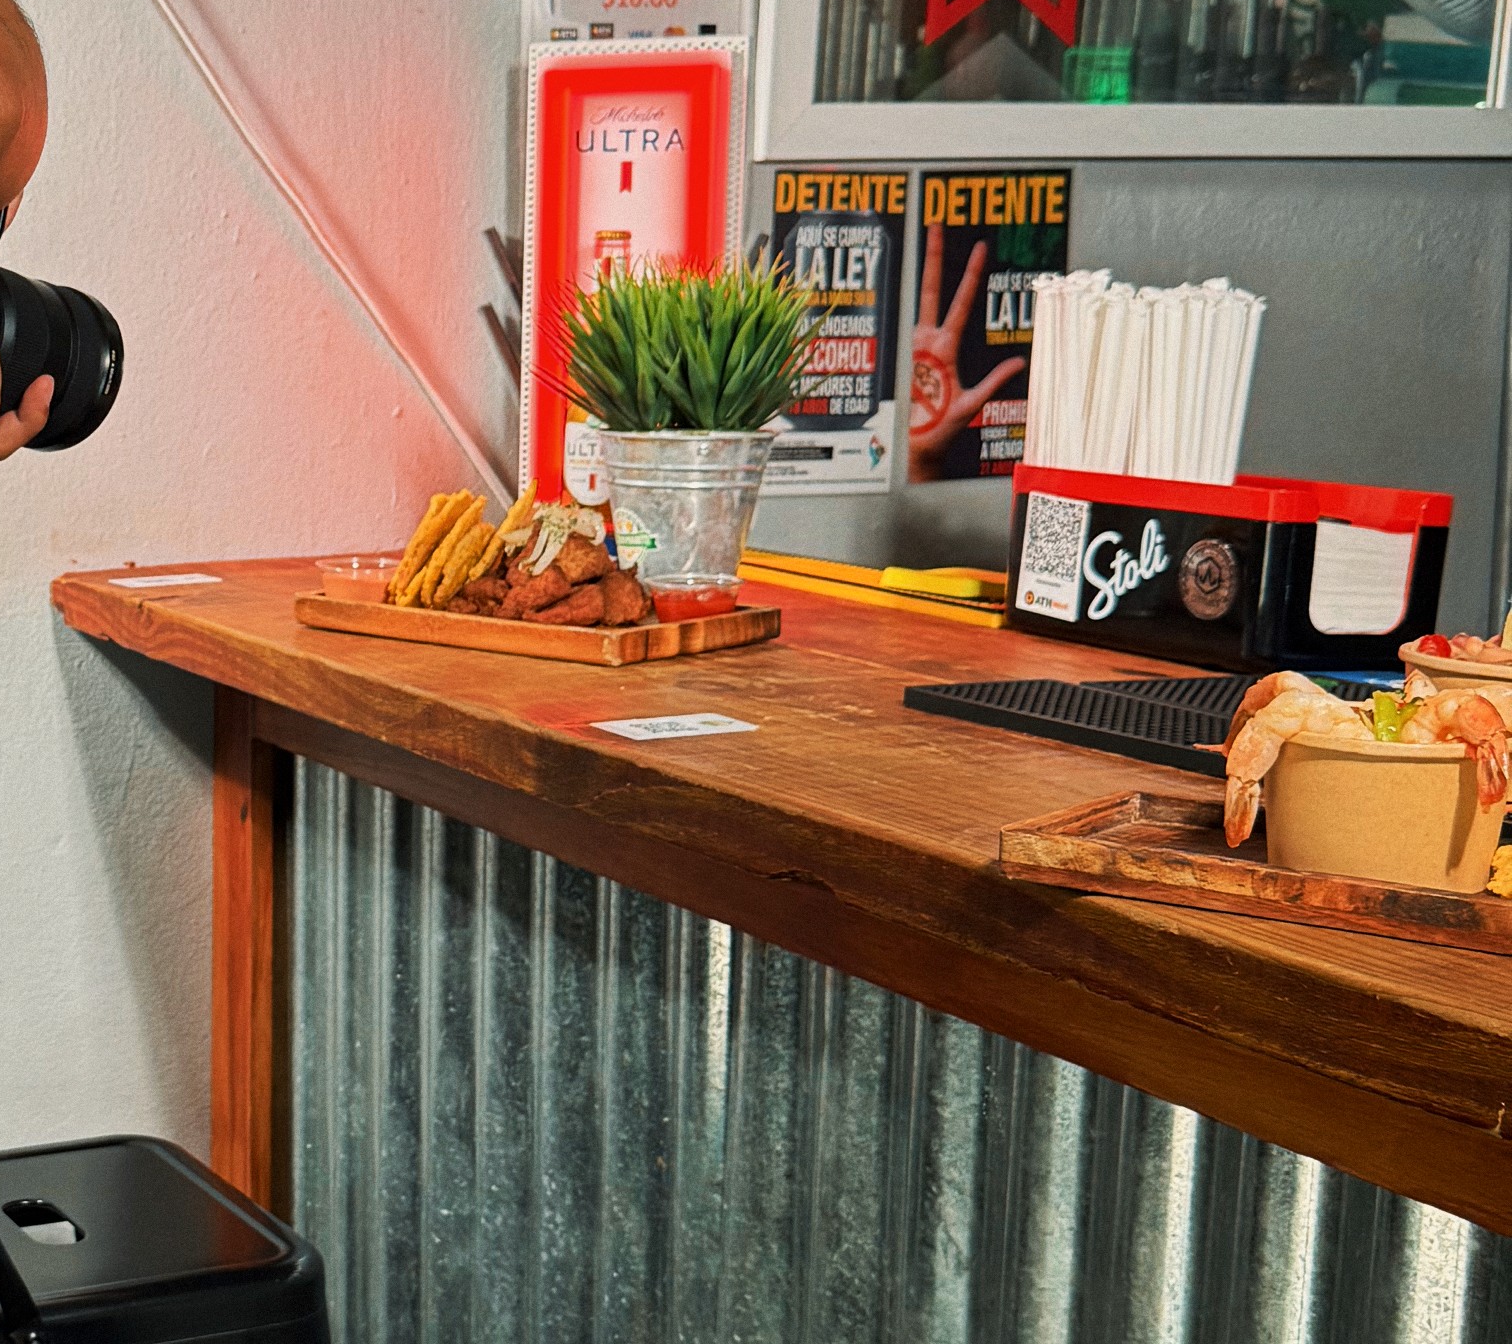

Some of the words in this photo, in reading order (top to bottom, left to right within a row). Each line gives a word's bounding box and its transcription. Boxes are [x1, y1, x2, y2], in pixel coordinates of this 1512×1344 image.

[576, 129, 685, 153] ULTRA
[775, 173, 906, 214] DETENTE
[924, 176, 1065, 227] DETENTE
[823, 226, 837, 247] SE
[795, 247, 827, 291] LA
[832, 248, 882, 291] LEY
[986, 291, 1014, 330] LA
[855, 376, 870, 396] DE
[1083, 518, 1170, 620] Stoli
